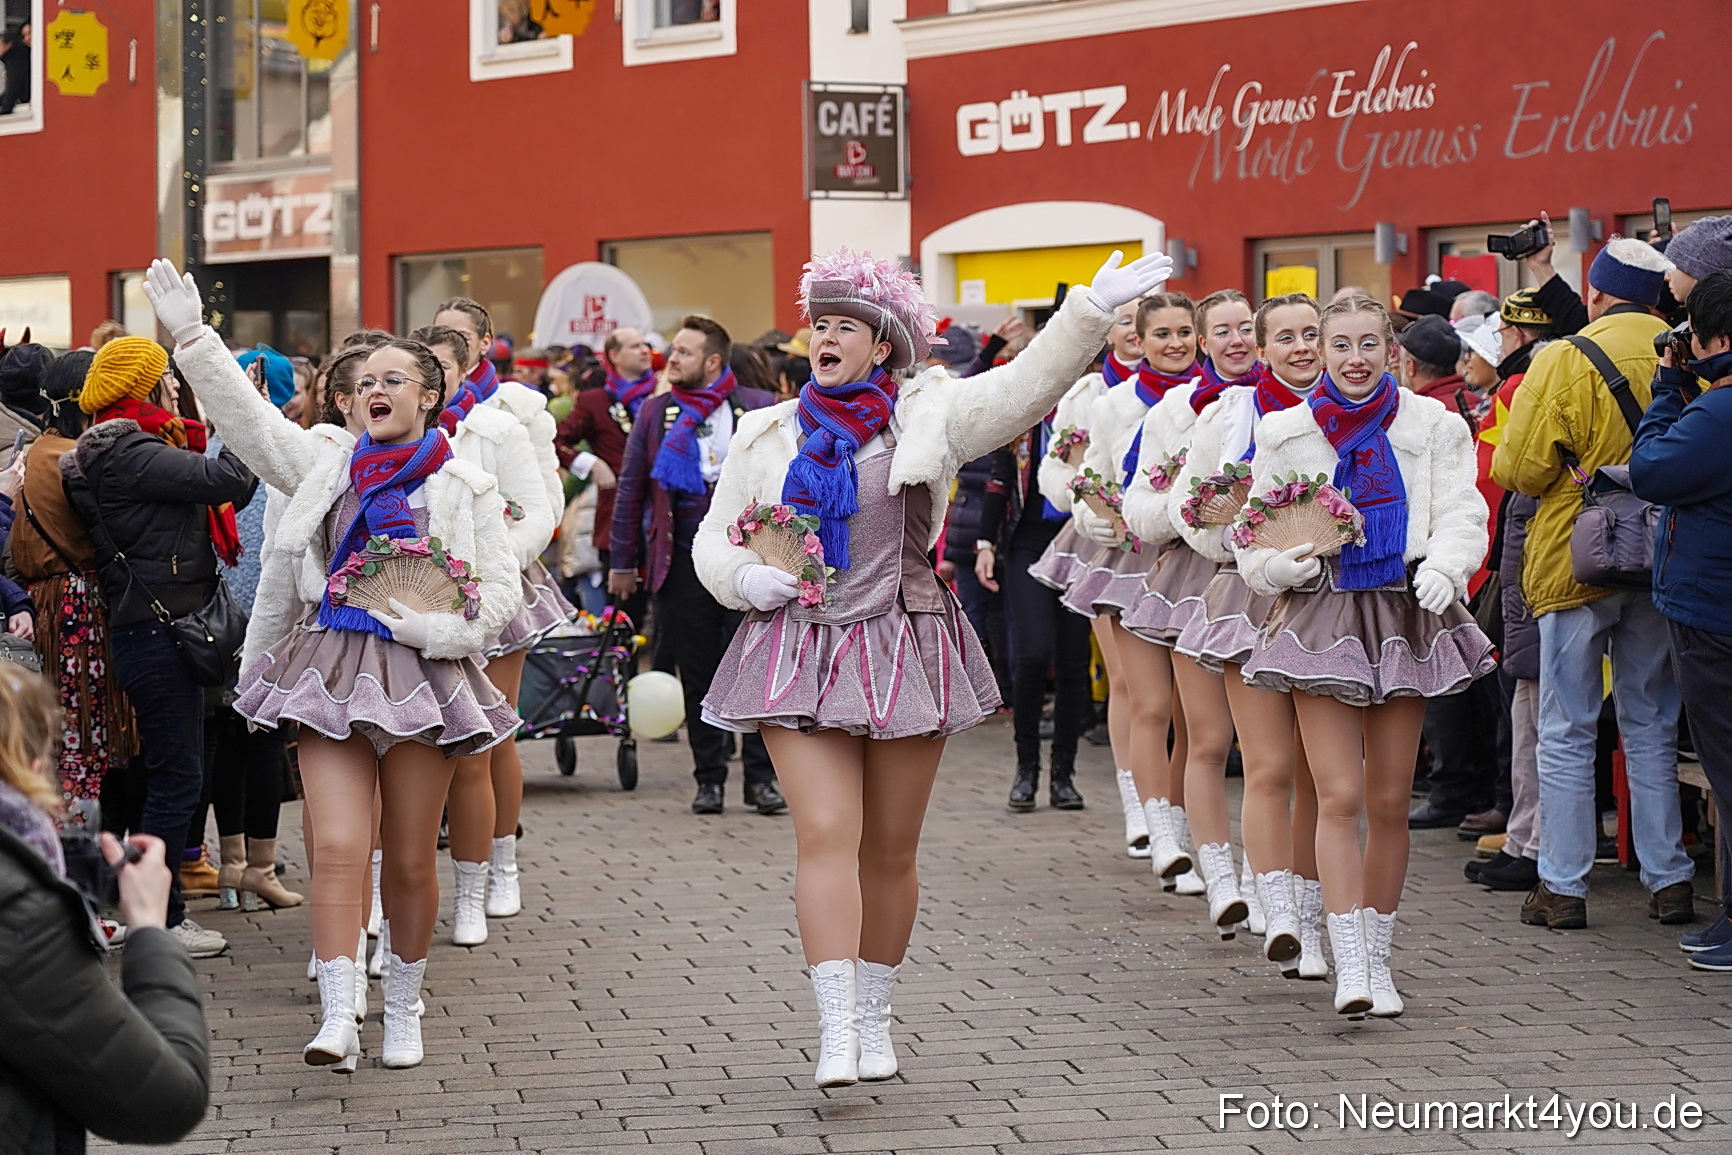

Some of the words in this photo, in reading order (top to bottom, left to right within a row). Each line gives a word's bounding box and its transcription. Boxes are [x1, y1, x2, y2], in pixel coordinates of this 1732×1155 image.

[817, 94, 895, 138] CAFÉ
[1147, 63, 1231, 142] Mode
[1231, 81, 1319, 152] Genuss
[1327, 40, 1437, 119] Erlebnis
[1503, 29, 1699, 160] Erlebnis
[204, 192, 333, 241] GÖTZ
